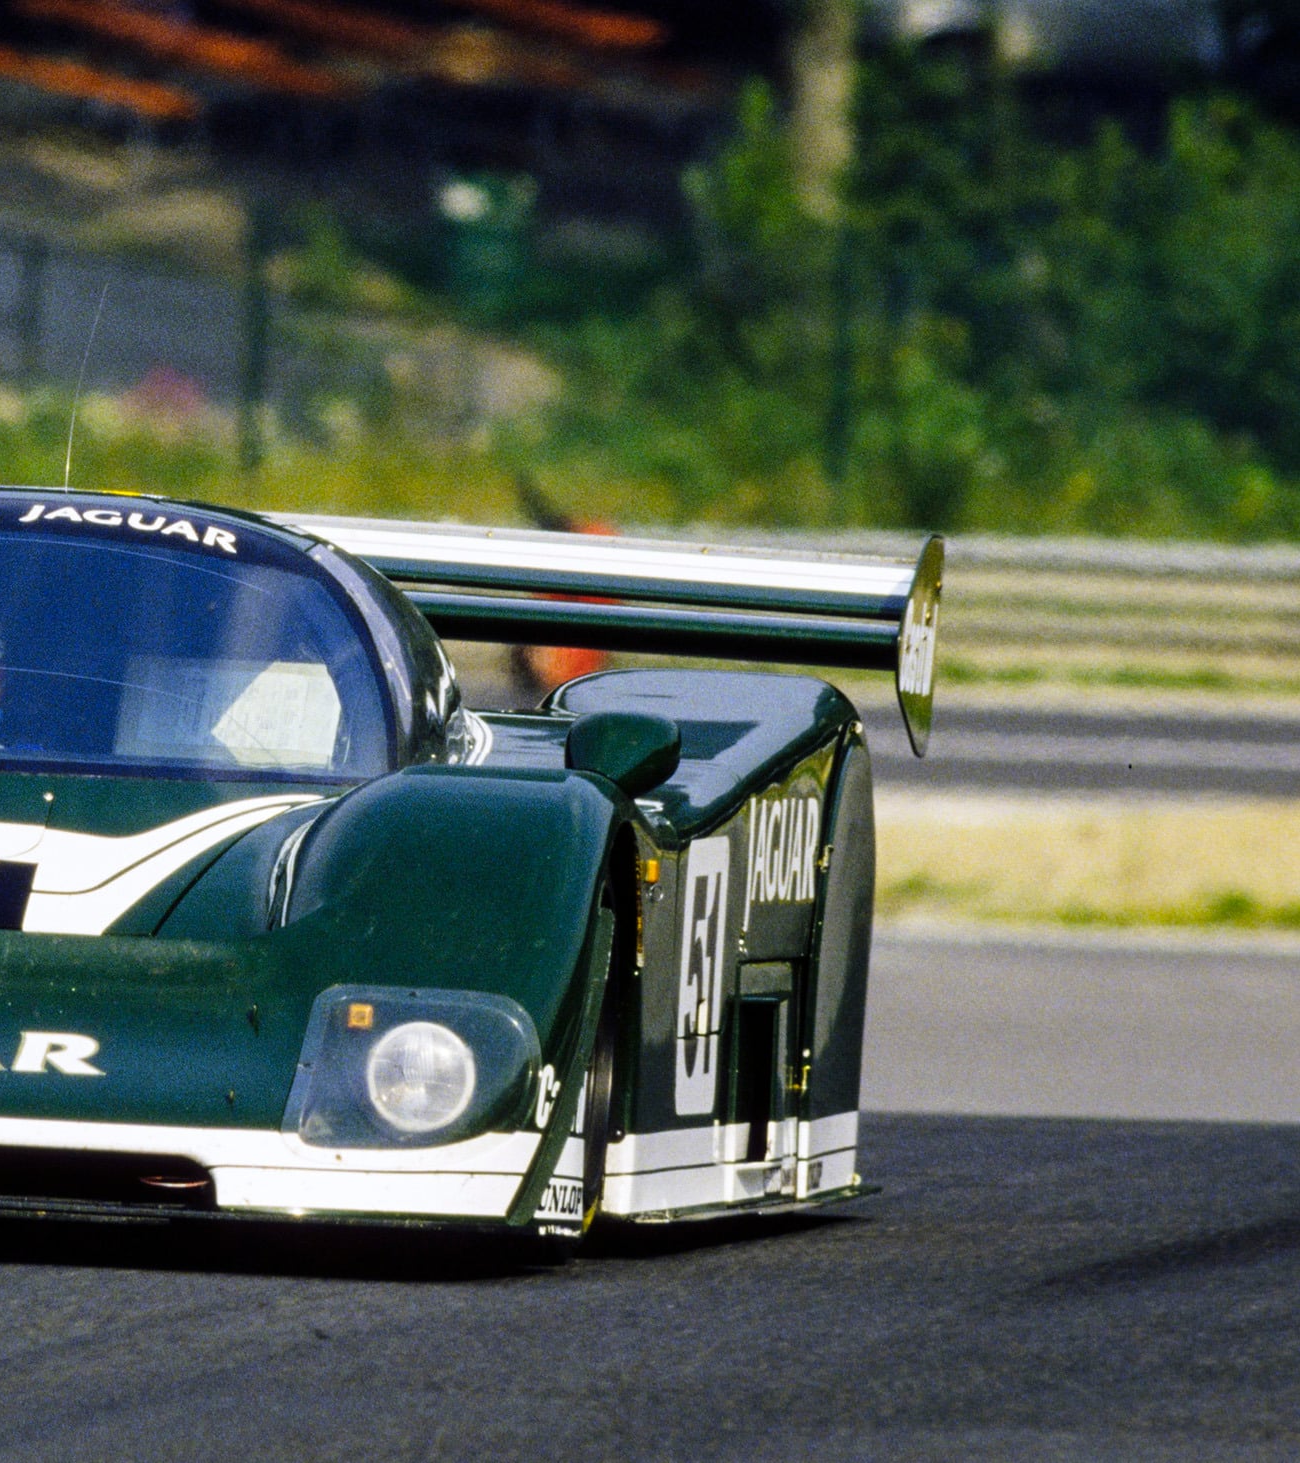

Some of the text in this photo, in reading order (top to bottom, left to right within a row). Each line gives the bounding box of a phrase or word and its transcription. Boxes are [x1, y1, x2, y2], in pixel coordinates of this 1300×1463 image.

[18, 503, 238, 555] JAGUAR
[742, 796, 819, 933] JAGUAR
[682, 871, 722, 1079] 51
